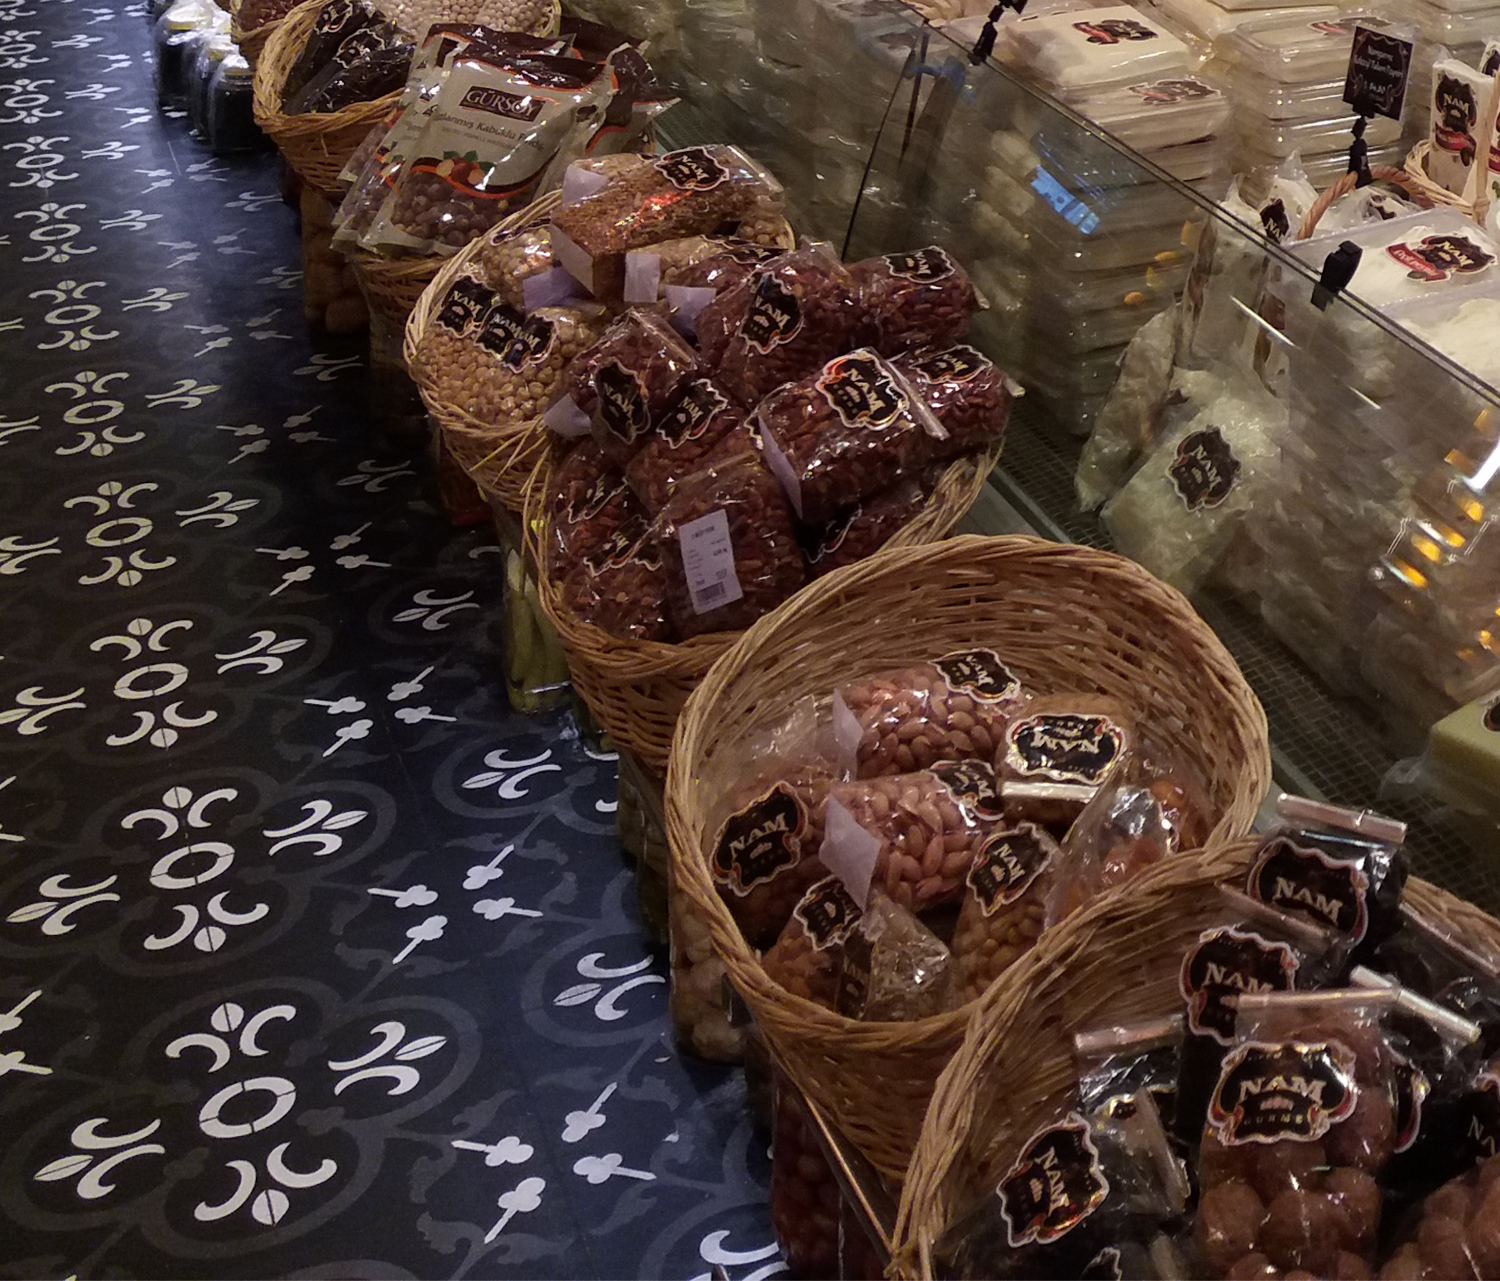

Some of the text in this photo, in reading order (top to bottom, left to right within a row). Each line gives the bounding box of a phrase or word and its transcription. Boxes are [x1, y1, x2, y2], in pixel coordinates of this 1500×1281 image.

[465, 89, 542, 118] GÜRSOY
[1442, 93, 1470, 116] NAM
[477, 122, 515, 140] Kabuklu
[681, 154, 708, 181] NAM
[915, 251, 932, 275] NAM
[1440, 239, 1474, 267] NAM
[448, 290, 483, 318] NAM
[490, 313, 522, 339] NAM
[849, 368, 887, 415] NAM
[679, 395, 704, 422] NAM
[964, 654, 994, 687] NAM
[1029, 733, 1101, 755] NAM
[727, 812, 788, 852] NAM
[998, 844, 1027, 880] NAM
[1274, 877, 1340, 922] NAM
[1204, 960, 1273, 997] NAM
[1238, 1074, 1326, 1109] NAM
[1034, 1146, 1069, 1213] NAM
